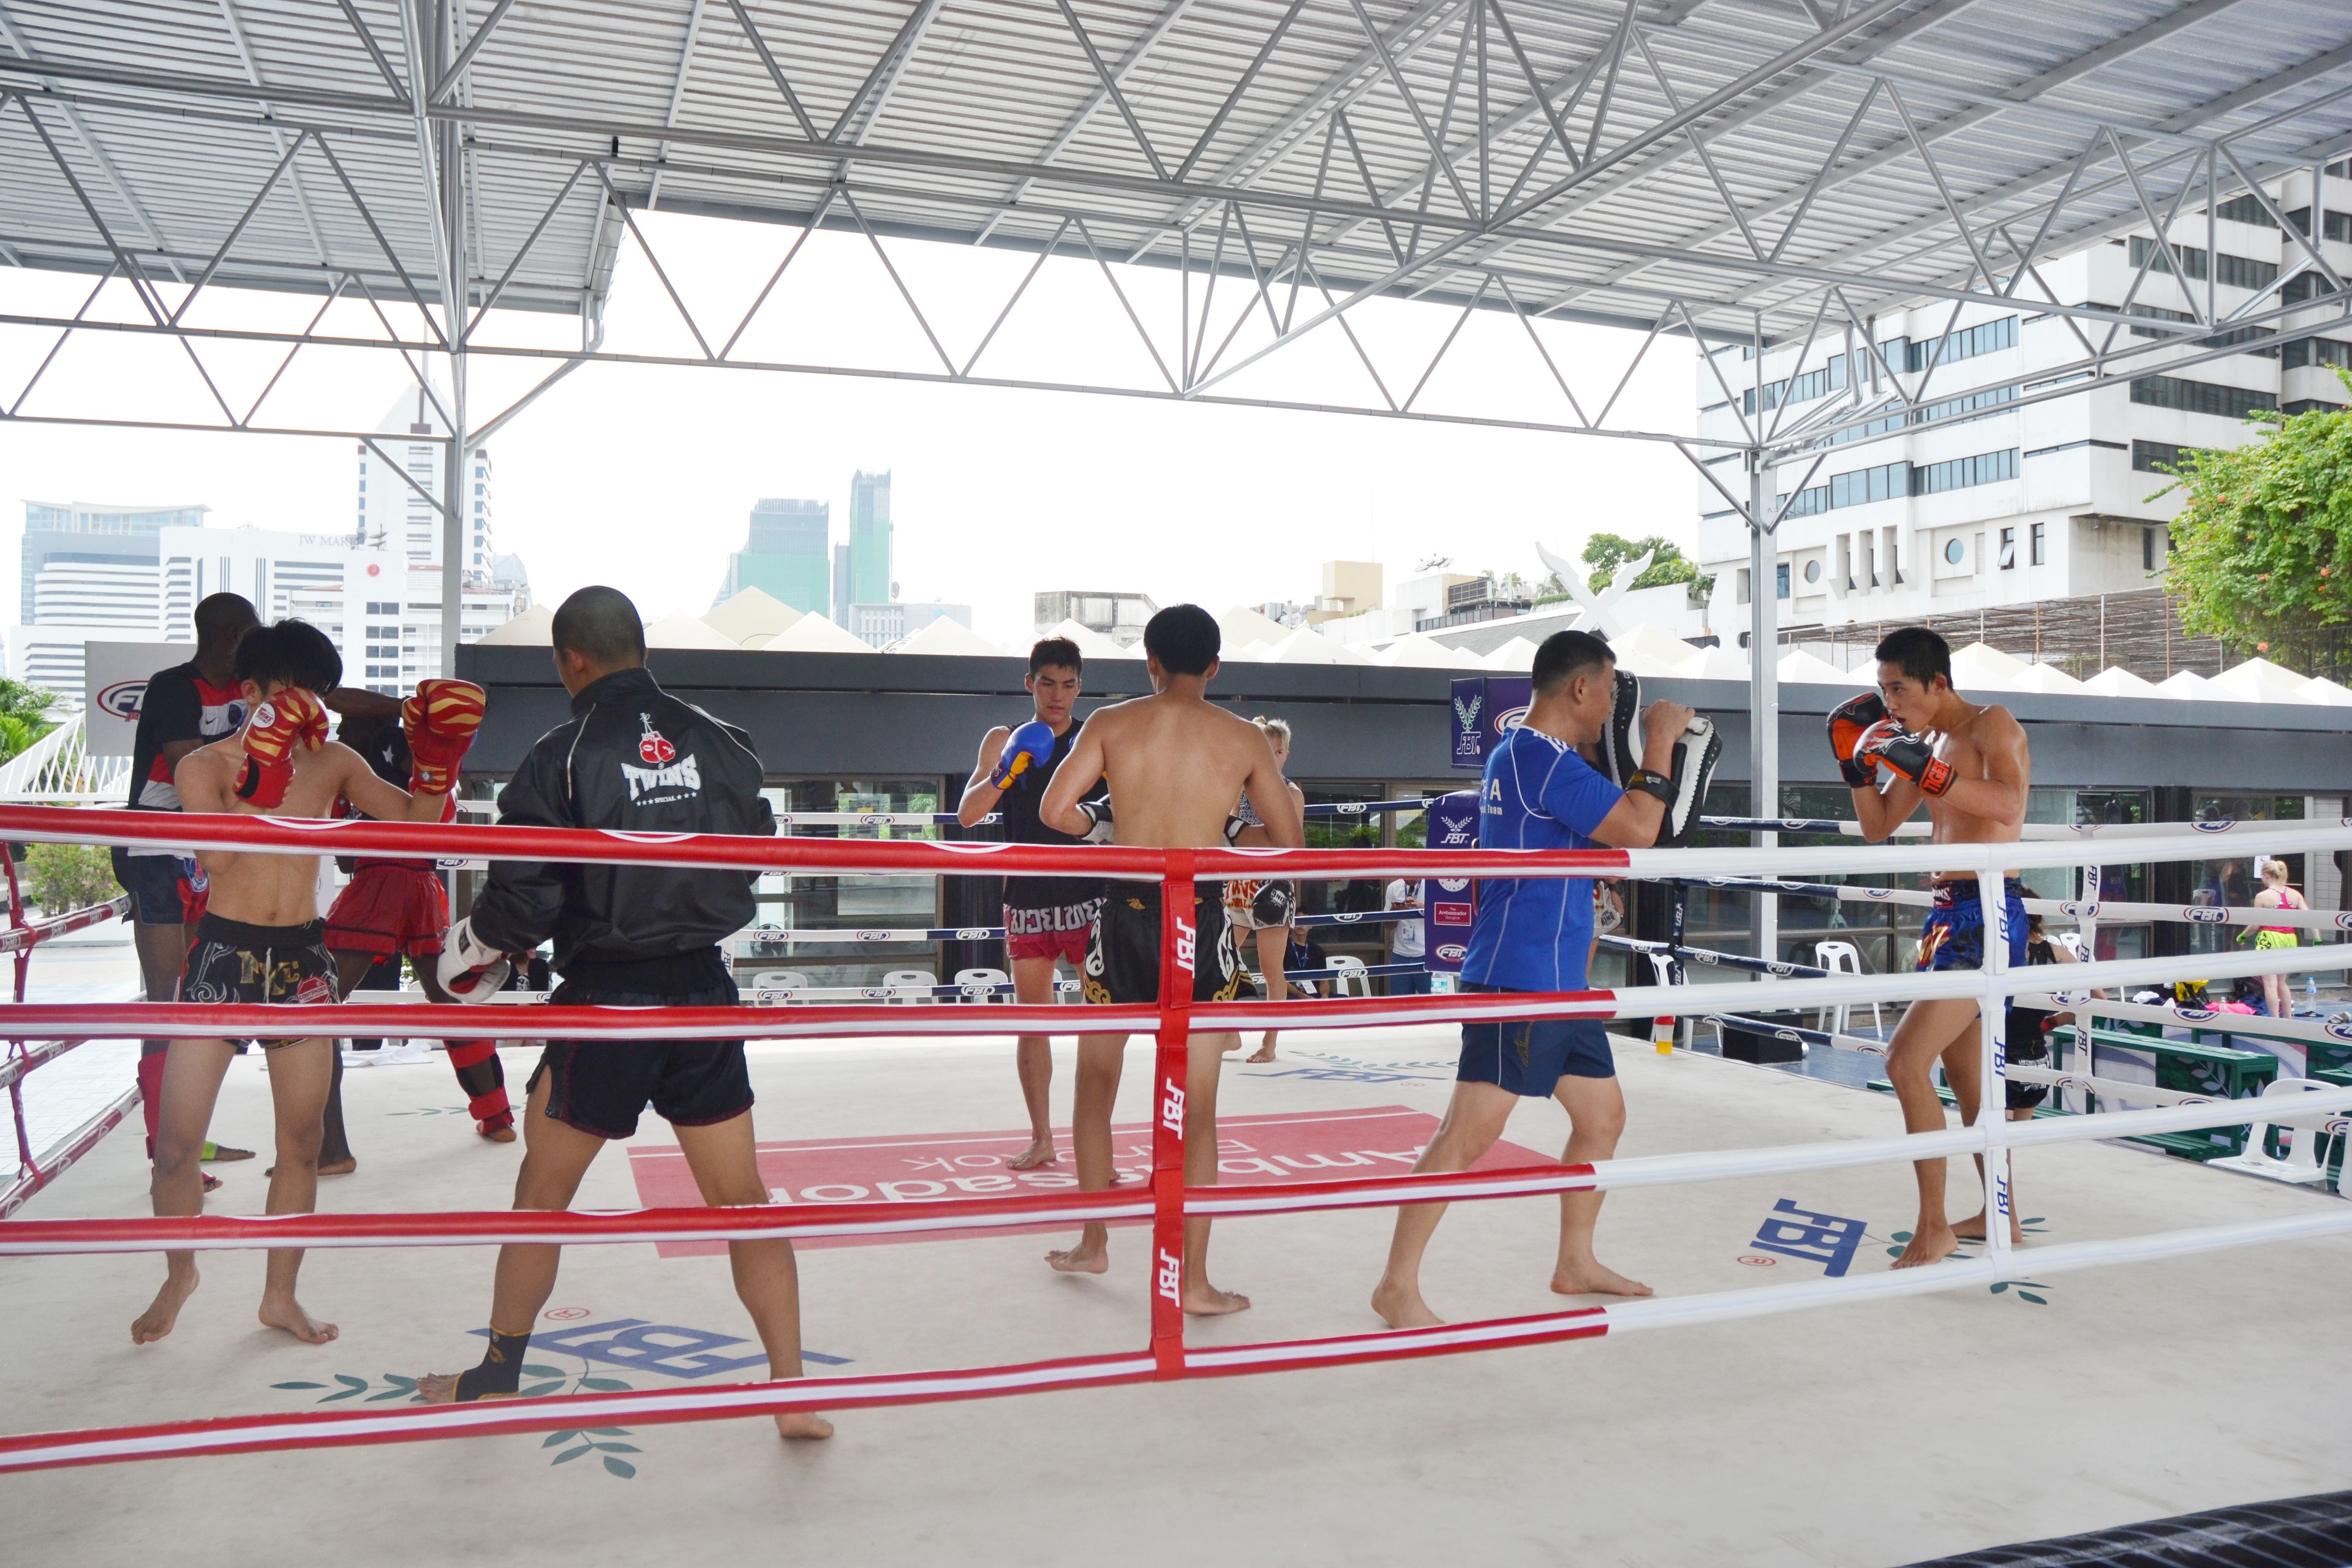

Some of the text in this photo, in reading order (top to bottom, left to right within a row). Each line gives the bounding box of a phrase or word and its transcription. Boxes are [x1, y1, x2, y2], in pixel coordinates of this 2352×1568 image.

[299, 535, 316, 546] JW
[620, 753, 701, 801] TWINS
[1924, 760, 1950, 792] TIGER
[1339, 804, 1363, 813] FBT
[1487, 804, 1503, 815] Team
[1441, 833, 1470, 844] FBT
[2087, 865, 2098, 891] FBT
[2190, 910, 2222, 922] FBT
[759, 932, 785, 940] FBT
[862, 931, 888, 940] FBT
[959, 930, 987, 939] FBT
[1177, 916, 1196, 979] FBT
[1439, 948, 1465, 958] FBT
[2081, 943, 2090, 963] FB
[1341, 969, 1365, 978] FBT
[299, 987, 328, 1000] CONTENDER
[763, 990, 790, 1000] FBT
[867, 989, 894, 998] FBT
[964, 986, 992, 995] FBT
[2078, 1026, 2087, 1057] FBT
[1163, 1077, 1185, 1140] FBT
[1749, 1198, 1868, 1278] FBT
[1159, 1246, 1180, 1308] FBT
